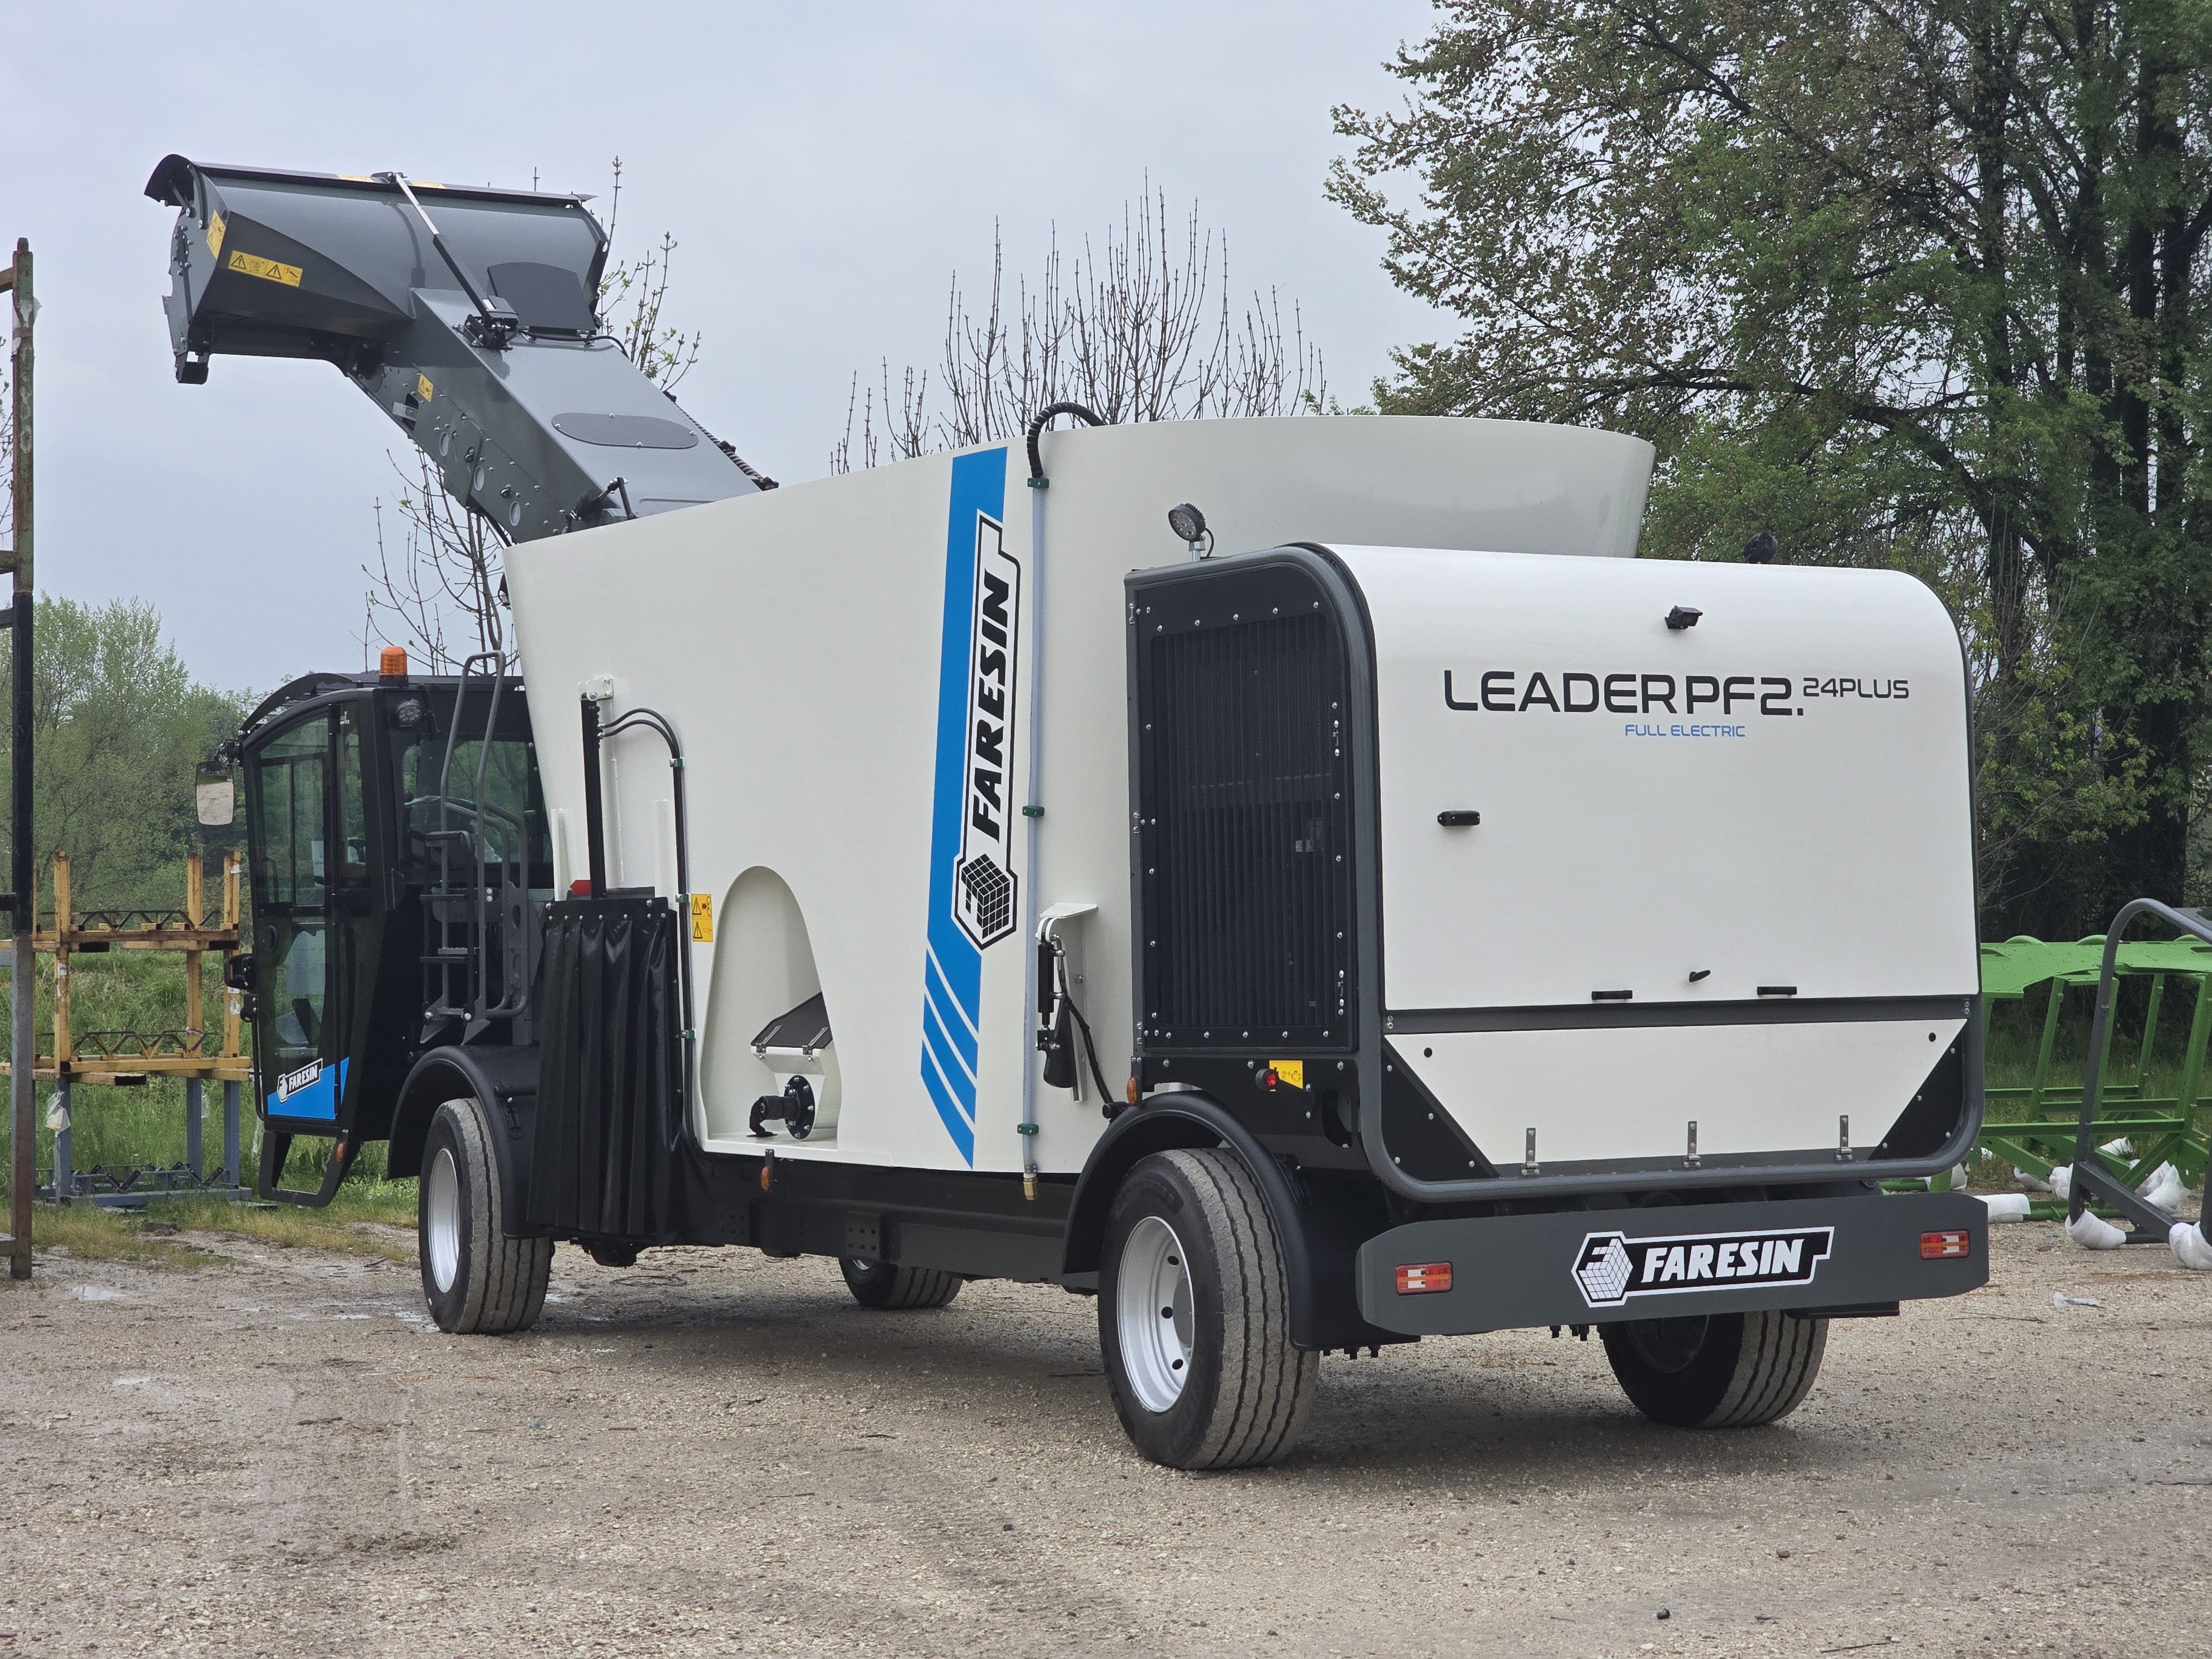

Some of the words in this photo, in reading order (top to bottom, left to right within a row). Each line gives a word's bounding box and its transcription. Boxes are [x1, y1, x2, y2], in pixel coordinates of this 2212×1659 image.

[972, 567, 1010, 844] FARESIN
[1444, 669, 1678, 714] LEADER
[1803, 677, 1910, 699] 24PLUS
[1625, 724, 1667, 737] FULL
[1670, 724, 1746, 738] ELECTRIC
[289, 1064, 318, 1092] FARESIN
[1640, 1238, 1805, 1284] FARESIN
